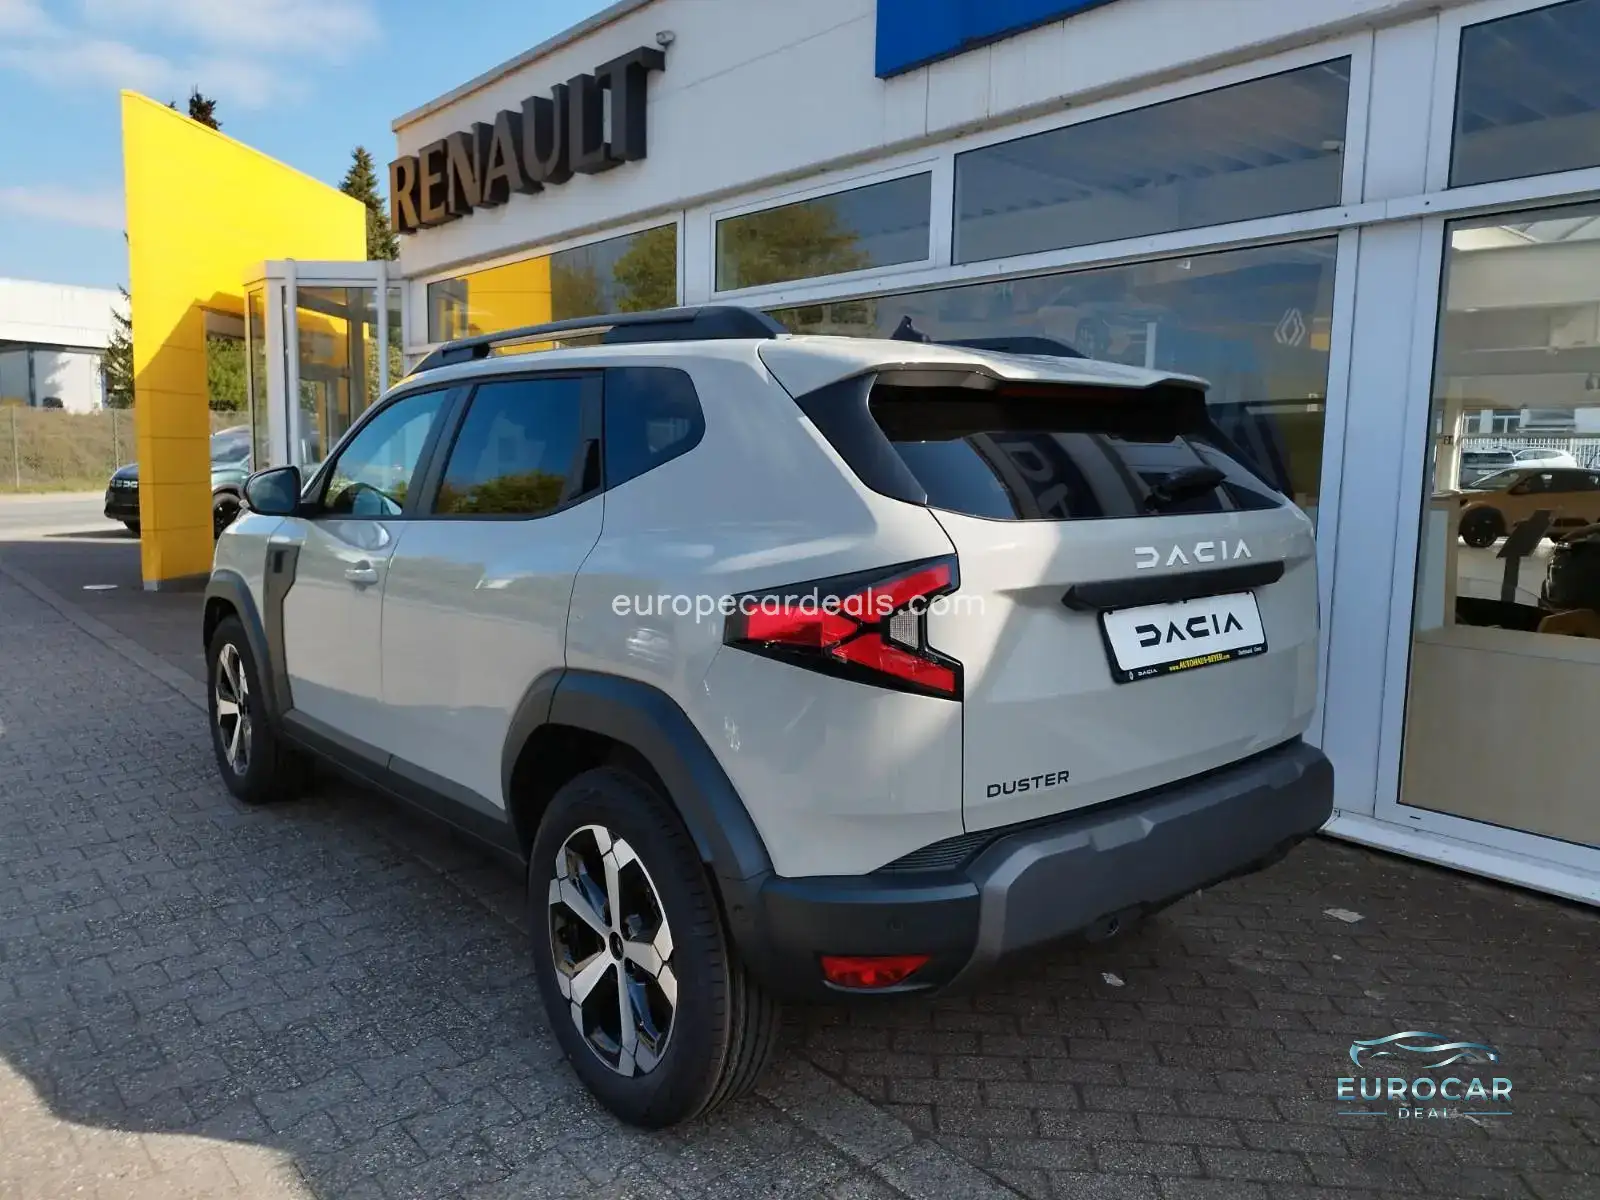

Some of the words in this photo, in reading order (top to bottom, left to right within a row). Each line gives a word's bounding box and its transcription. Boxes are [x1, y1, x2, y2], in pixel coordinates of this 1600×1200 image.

[388, 46, 666, 234] RENAULT
[1134, 539, 1252, 569] DACIA
[1135, 612, 1243, 648] DACIA
[986, 770, 1070, 798] DUSTER
